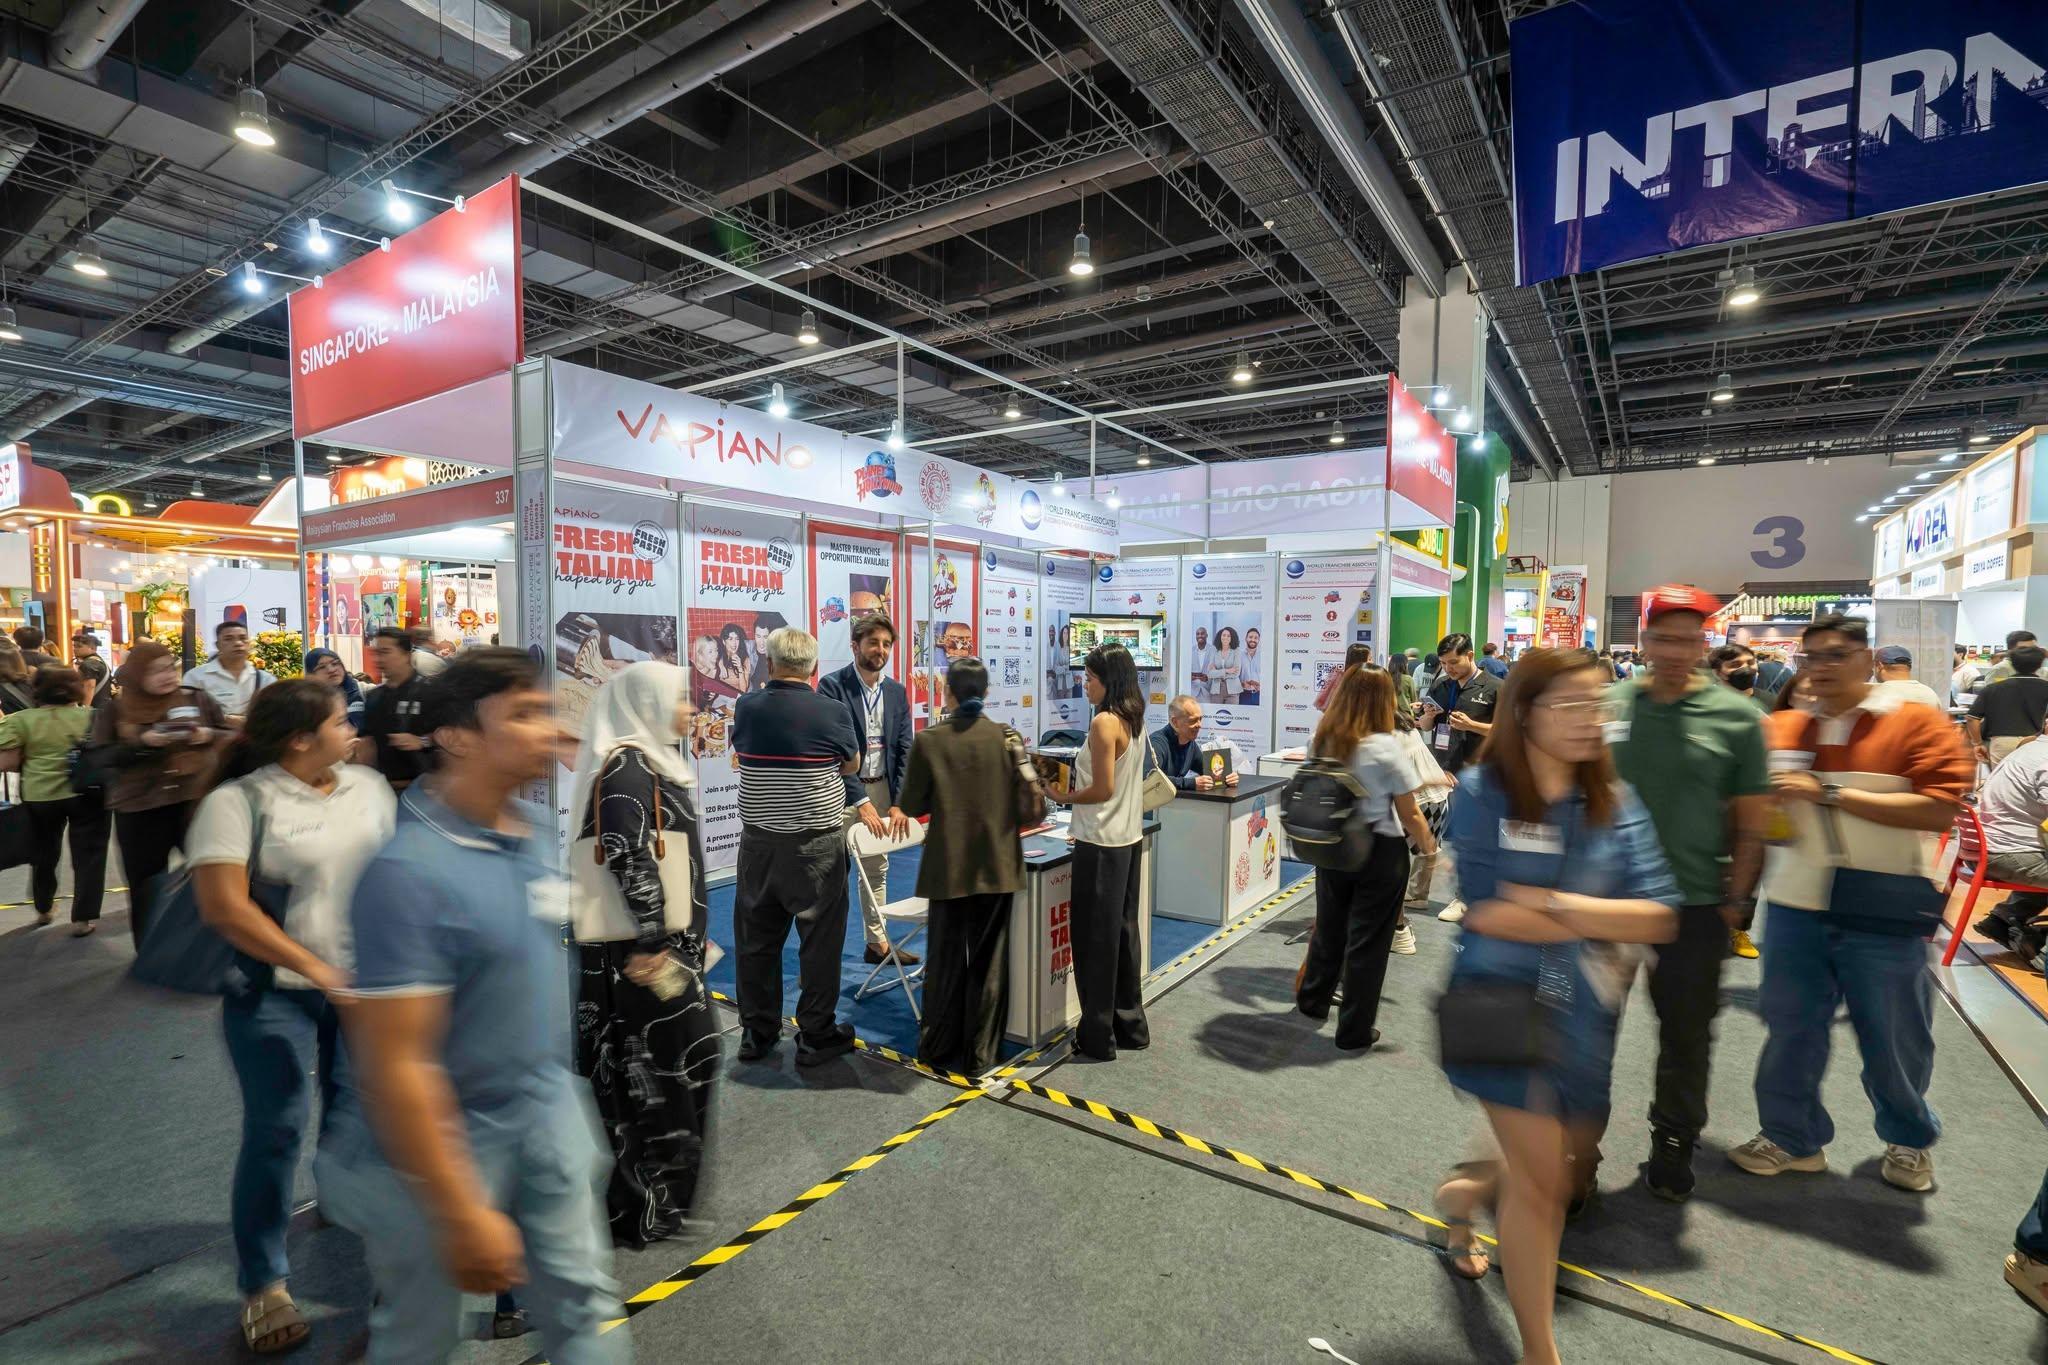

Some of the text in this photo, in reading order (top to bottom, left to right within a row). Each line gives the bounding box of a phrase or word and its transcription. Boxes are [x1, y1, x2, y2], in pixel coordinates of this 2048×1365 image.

[300, 318, 389, 376] SINGAPORE
[403, 266, 501, 334] MALAYSIA
[854, 464, 888, 488] PLANET
[922, 462, 941, 477] EARL
[1429, 456, 1453, 489] MALAYSIA
[495, 489, 510, 504] 337
[306, 511, 396, 537] Malaysian Franchise Association
[1064, 507, 1091, 521] FRANCHISE
[1091, 516, 1117, 528] ASSOCIATES
[634, 528, 667, 546] FRESH
[1750, 515, 1807, 569] 3
[633, 538, 664, 557] PASTA
[701, 540, 768, 567] FRESH
[768, 544, 793, 561] FRESH
[830, 542, 880, 556] MASTER FRANCHISE
[556, 552, 654, 581] TALIAN
[767, 552, 791, 568] PASTA
[820, 552, 890, 567] OPPORTUNITIES AVAILABLE
[1973, 561, 1986, 574] EDIYA
[554, 566, 656, 596] haped by you
[701, 564, 784, 590] ITALIAN
[700, 580, 786, 602] shaped by you
[933, 596, 954, 614] Guy!
[705, 786, 718, 794] Join
[558, 807, 569, 815] oin
[706, 804, 739, 814] 120 Restau
[705, 814, 726, 823] across
[712, 833, 733, 843] proven
[706, 842, 734, 853] Business
